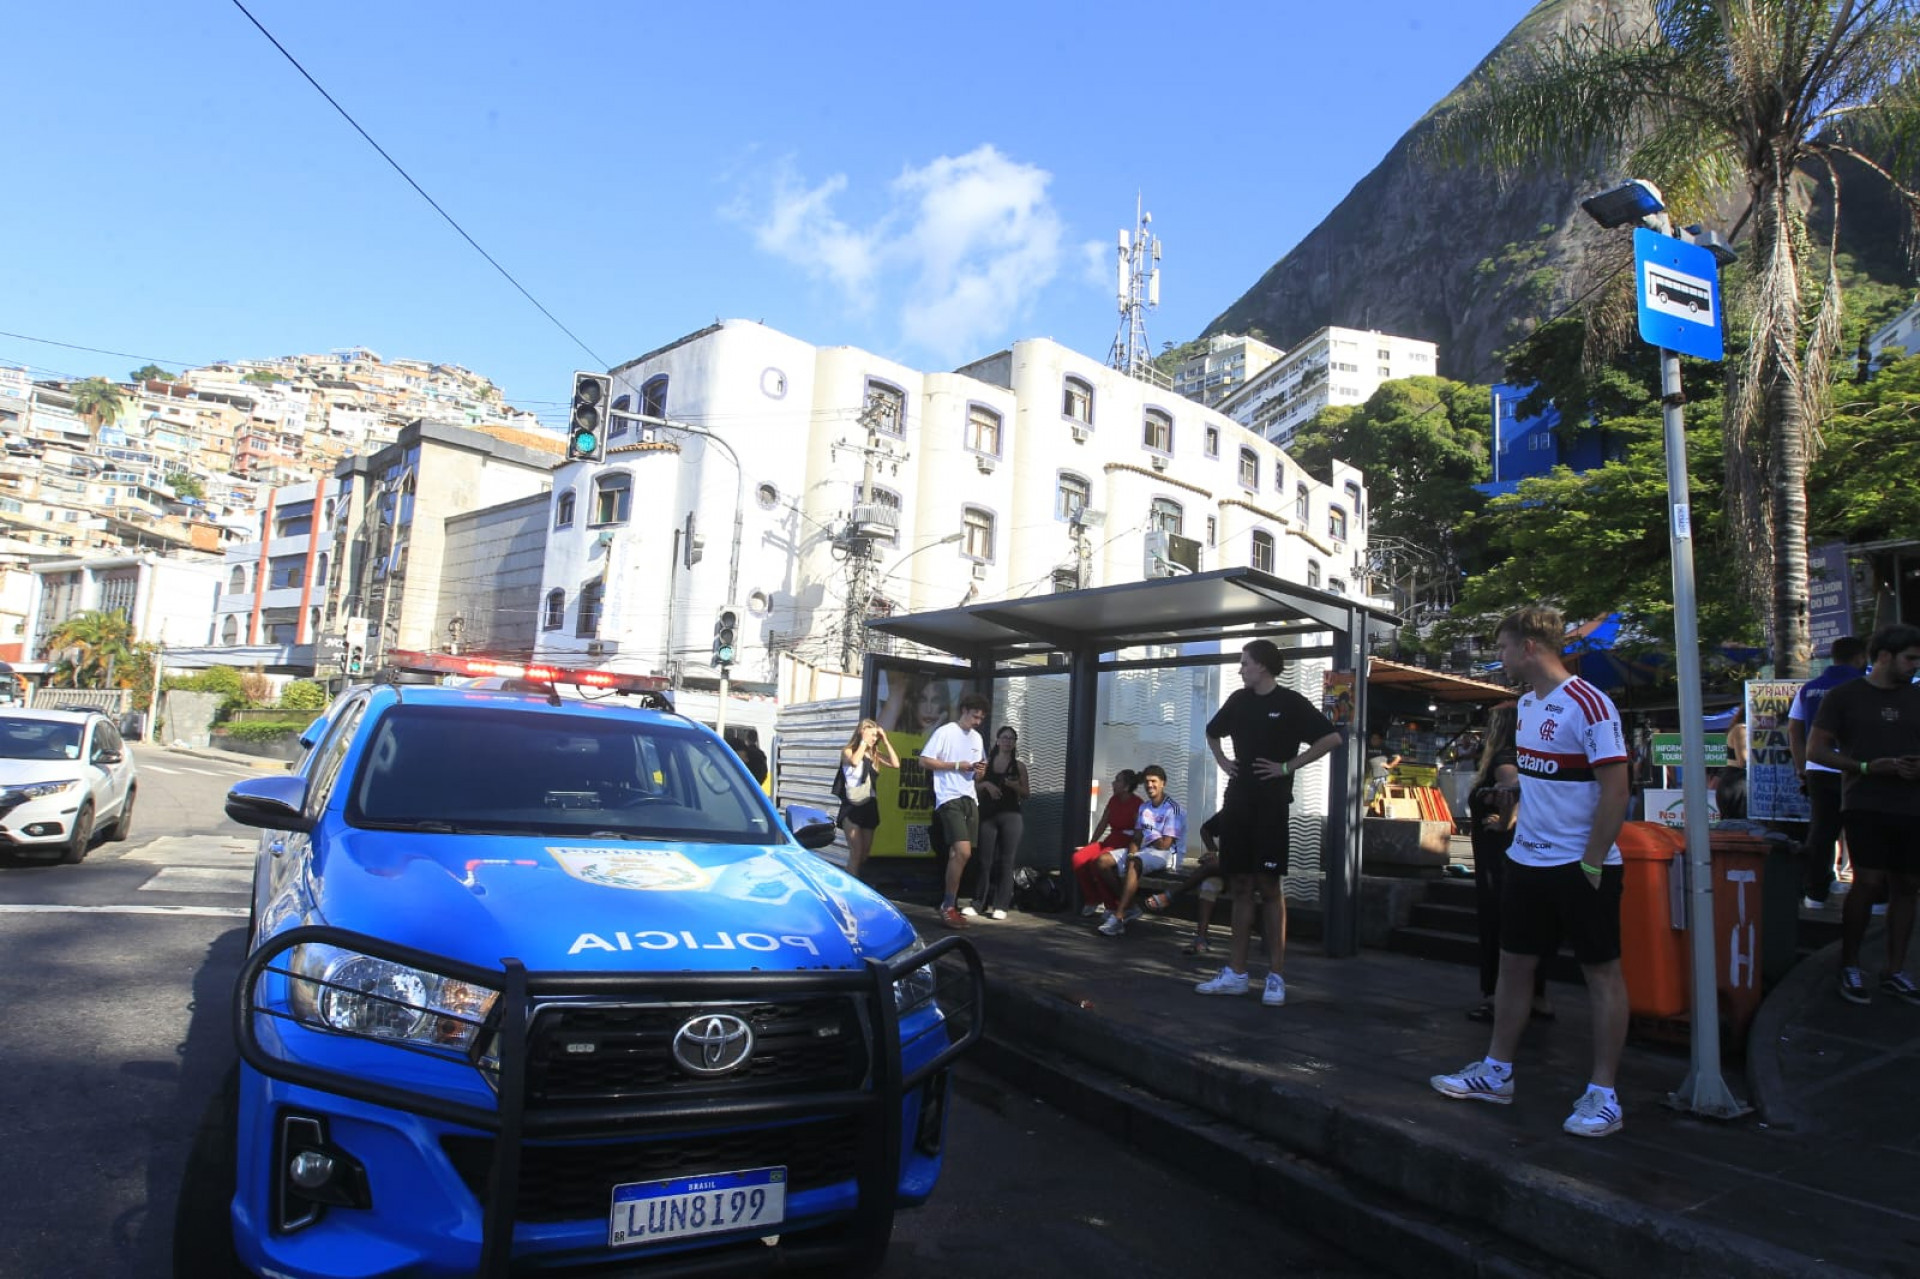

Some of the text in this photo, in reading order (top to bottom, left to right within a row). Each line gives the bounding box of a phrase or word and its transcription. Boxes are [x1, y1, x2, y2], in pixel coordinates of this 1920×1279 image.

[1824, 595, 1838, 607] RIO
[1752, 699, 1791, 712] VAN
[1656, 744, 1682, 752] INFORM
[1751, 748, 1792, 765] VID
[688, 1181, 716, 1192] BRASIL
[614, 1230, 625, 1243] BR
